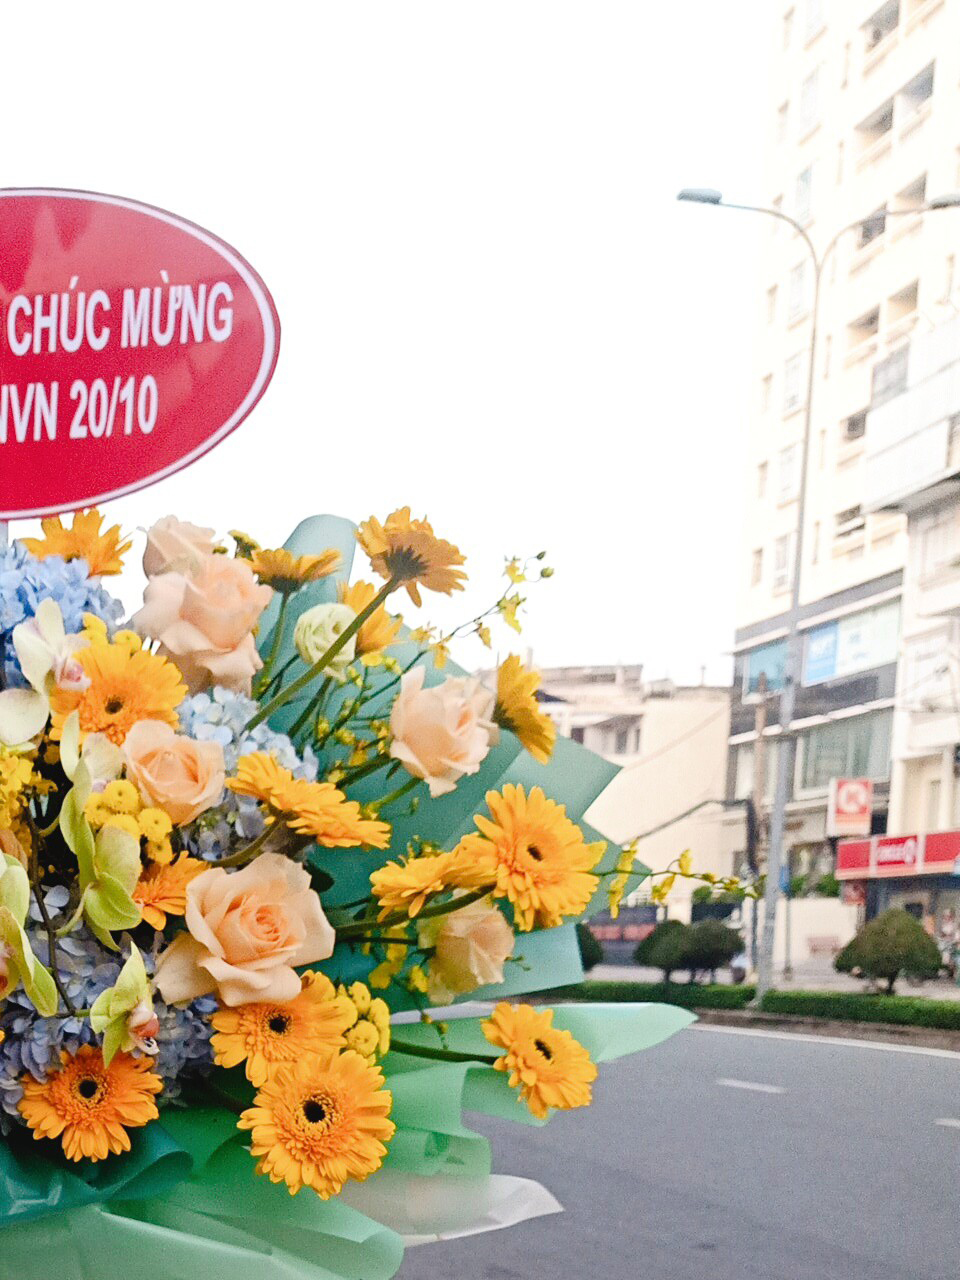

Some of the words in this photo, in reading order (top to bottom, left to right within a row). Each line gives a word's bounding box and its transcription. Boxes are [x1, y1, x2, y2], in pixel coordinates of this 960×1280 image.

[6, 275, 112, 358] CHÚC
[120, 269, 235, 349] MỪNG
[70, 374, 158, 440] 20/10
